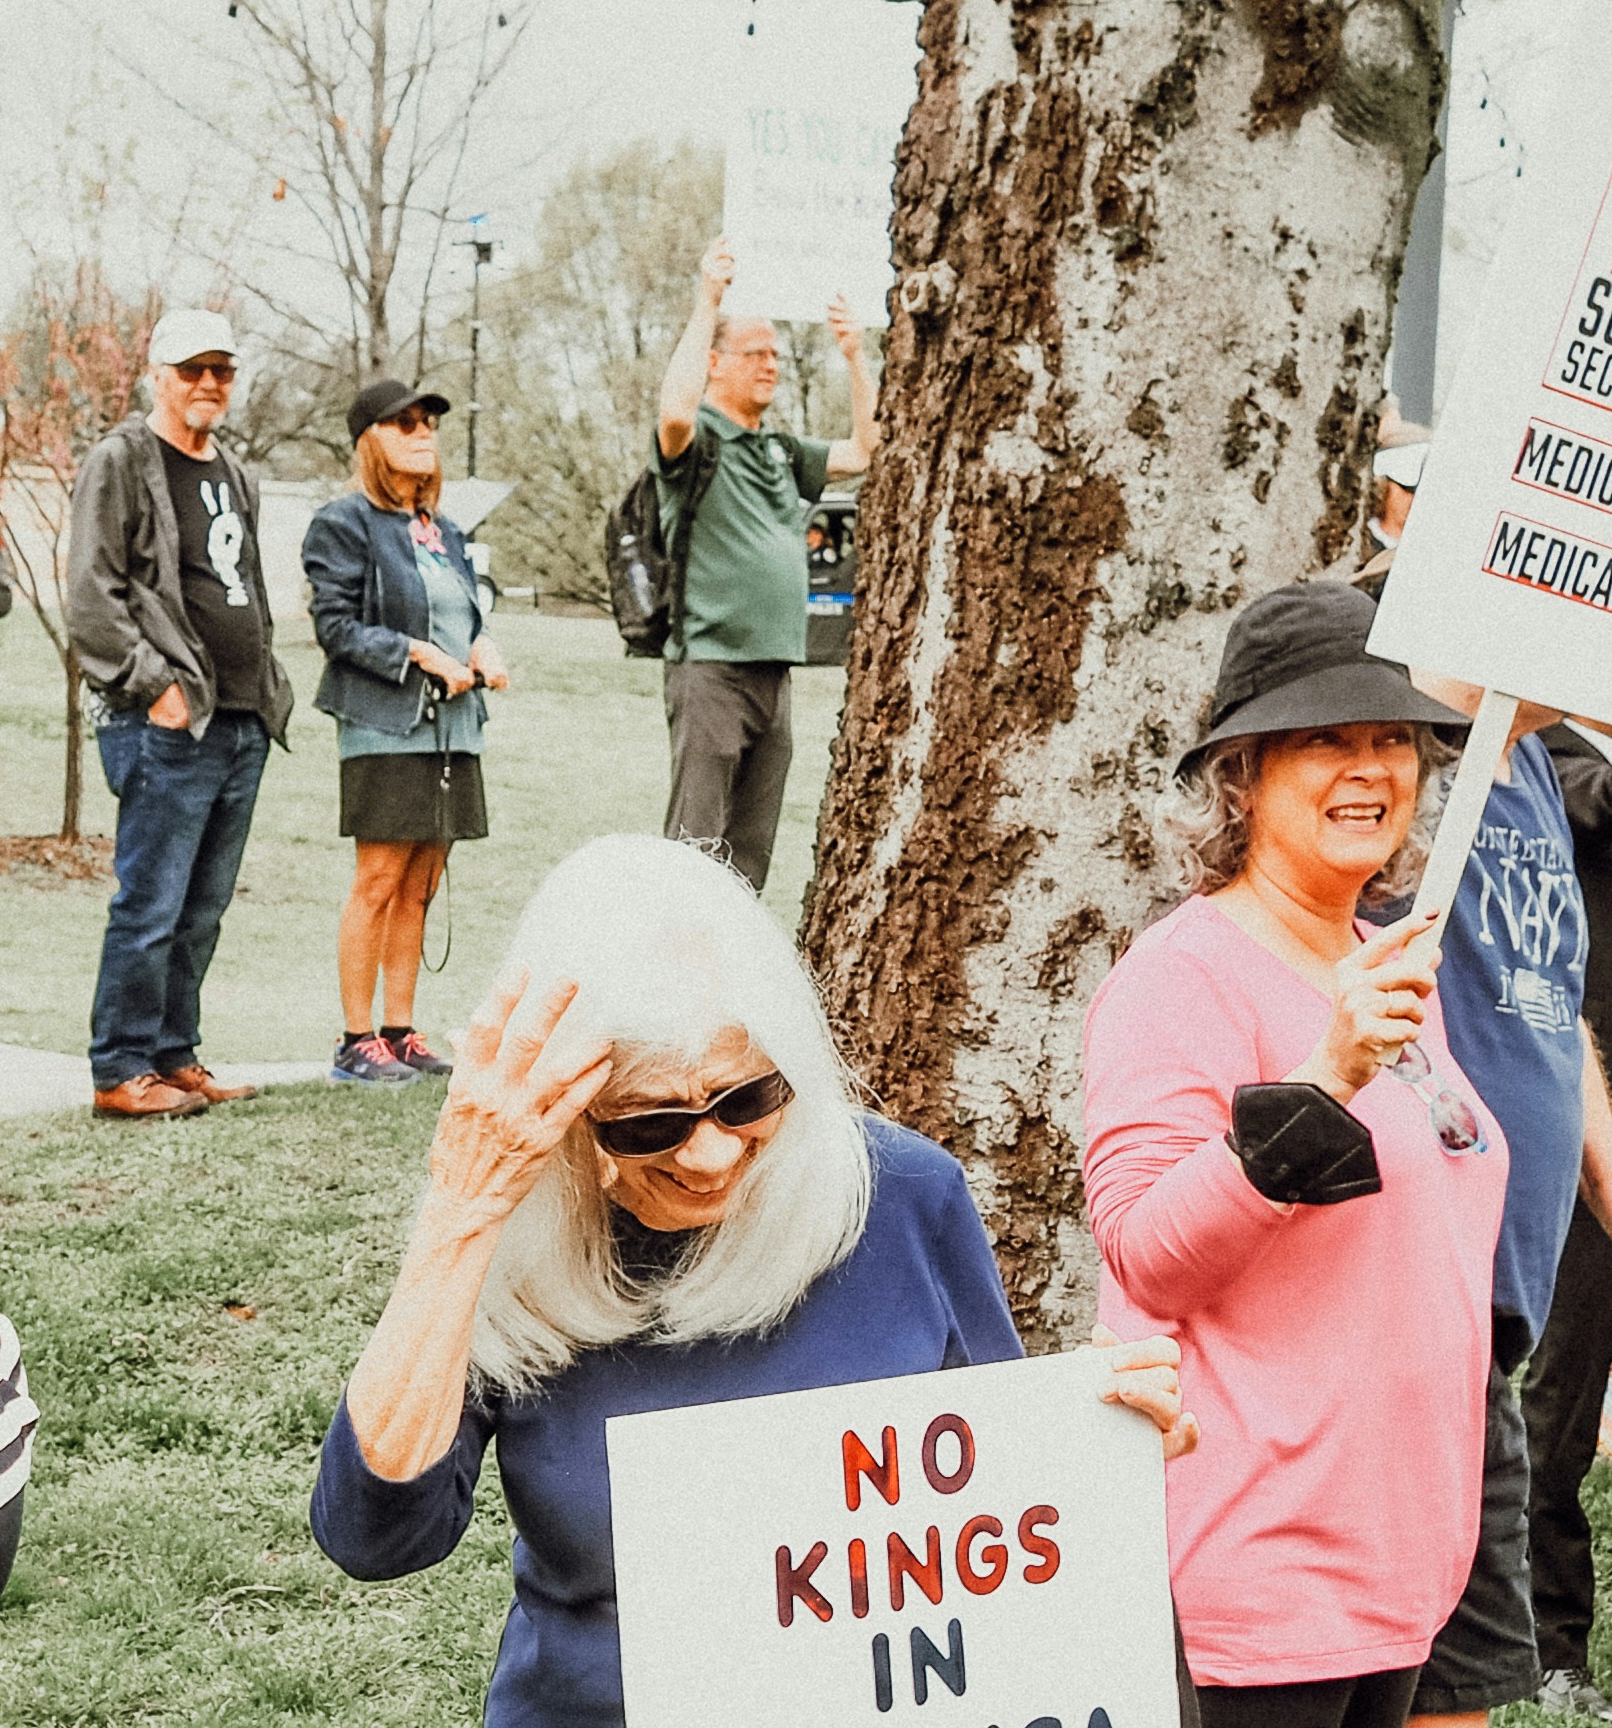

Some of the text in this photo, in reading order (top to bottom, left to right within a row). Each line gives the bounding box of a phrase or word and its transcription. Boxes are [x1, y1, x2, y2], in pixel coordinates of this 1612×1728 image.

[1470, 849, 1586, 972] NAVY
[841, 1413, 976, 1512] NO
[775, 1504, 1061, 1628] KINGS
[872, 1618, 967, 1713] IN
